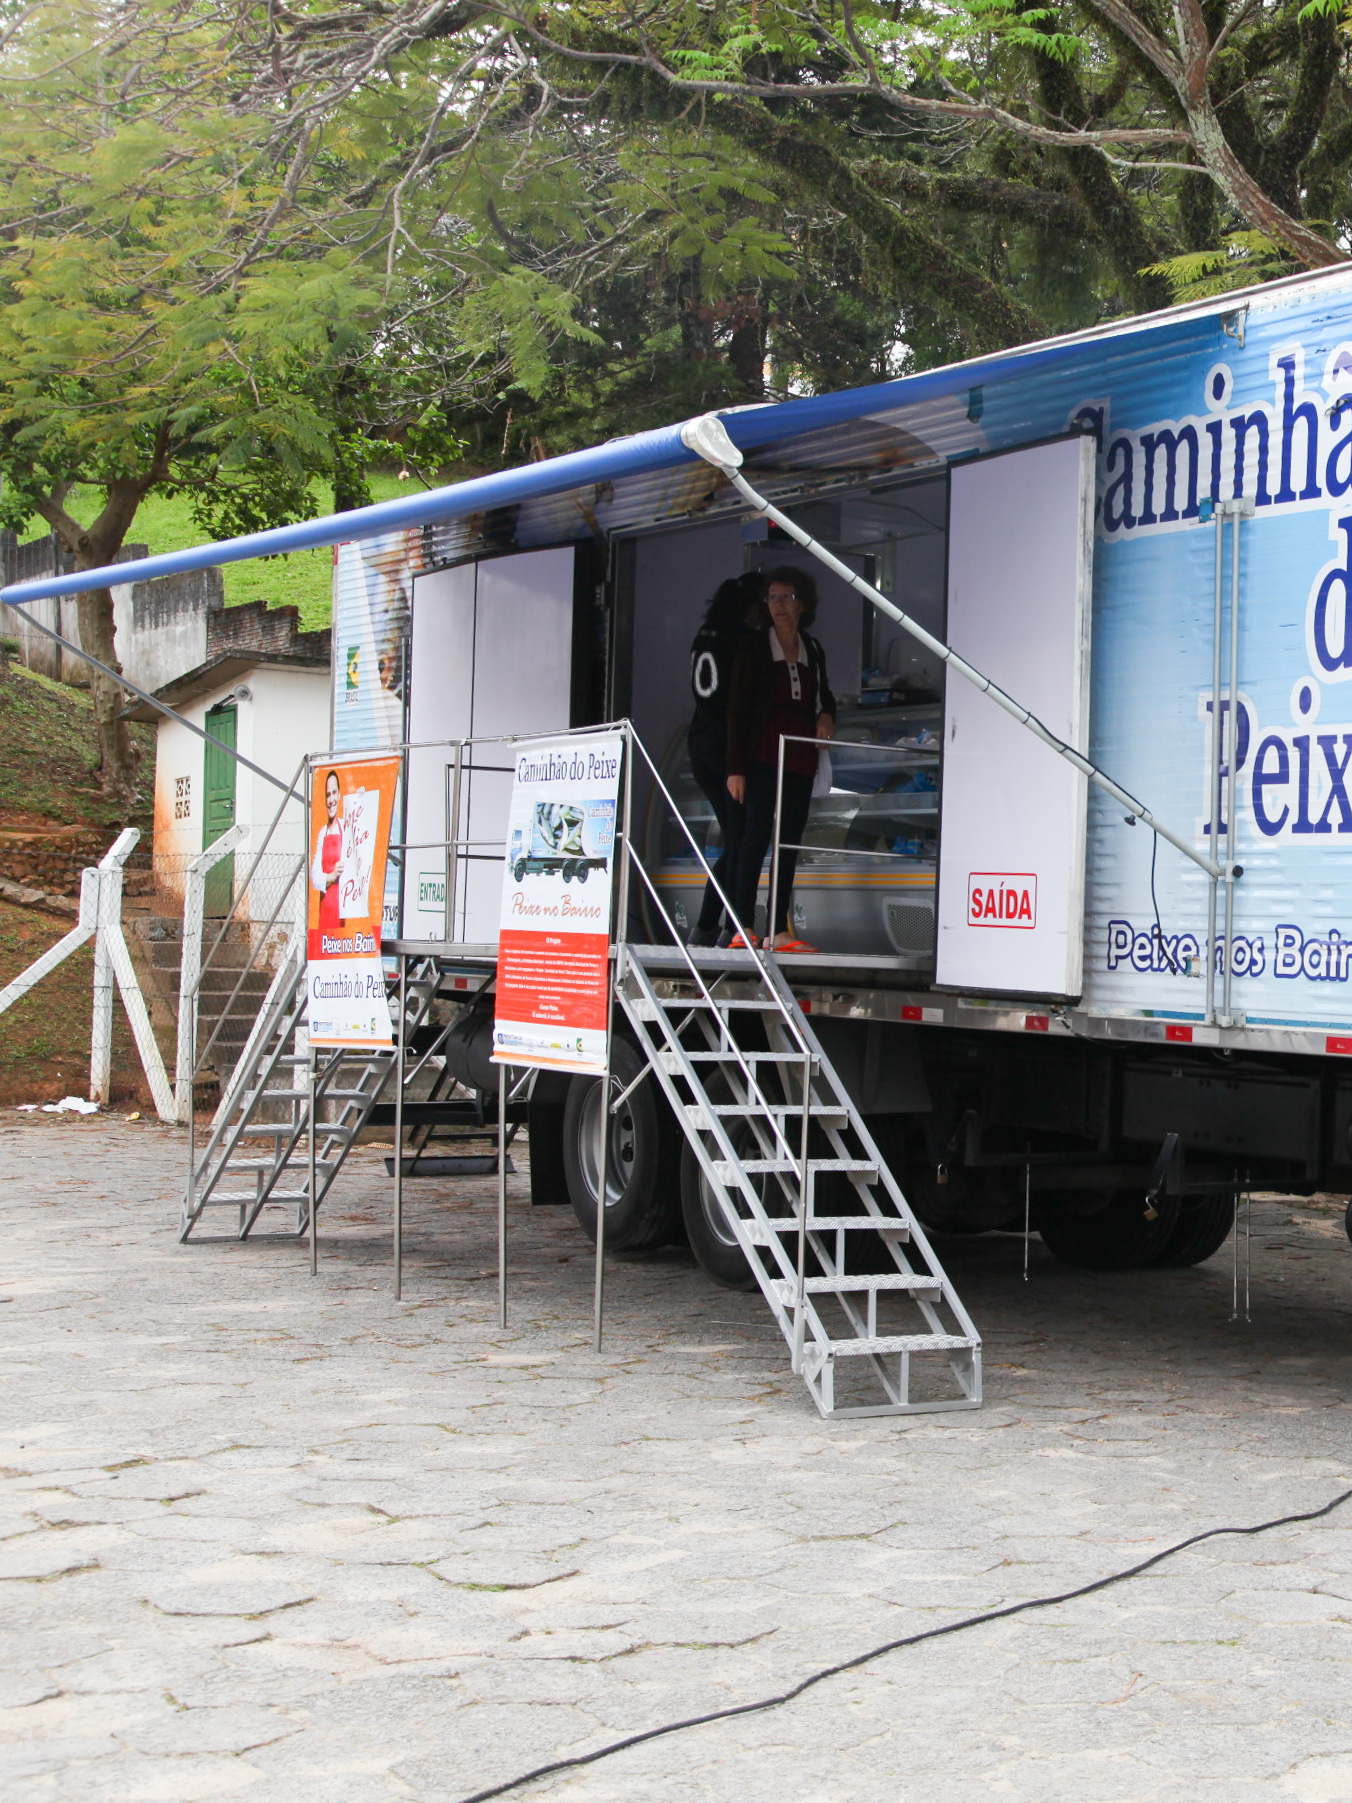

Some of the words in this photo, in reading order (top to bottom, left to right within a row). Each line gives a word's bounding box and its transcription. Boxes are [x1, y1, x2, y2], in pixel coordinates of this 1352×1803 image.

[518, 754, 568, 783] Caminhão
[570, 752, 584, 780] do
[588, 751, 617, 780] Peixe
[420, 882, 445, 902] ENTRAD
[512, 892, 541, 915] Peixe
[561, 894, 601, 918] Bairro
[971, 881, 1032, 920] SAÍDA
[321, 934, 341, 954] Peixe
[342, 938, 353, 954] nos
[1108, 920, 1199, 972] Peixe
[313, 973, 352, 999] Caminhão
[354, 973, 363, 998] do
[366, 974, 386, 998] Peix
